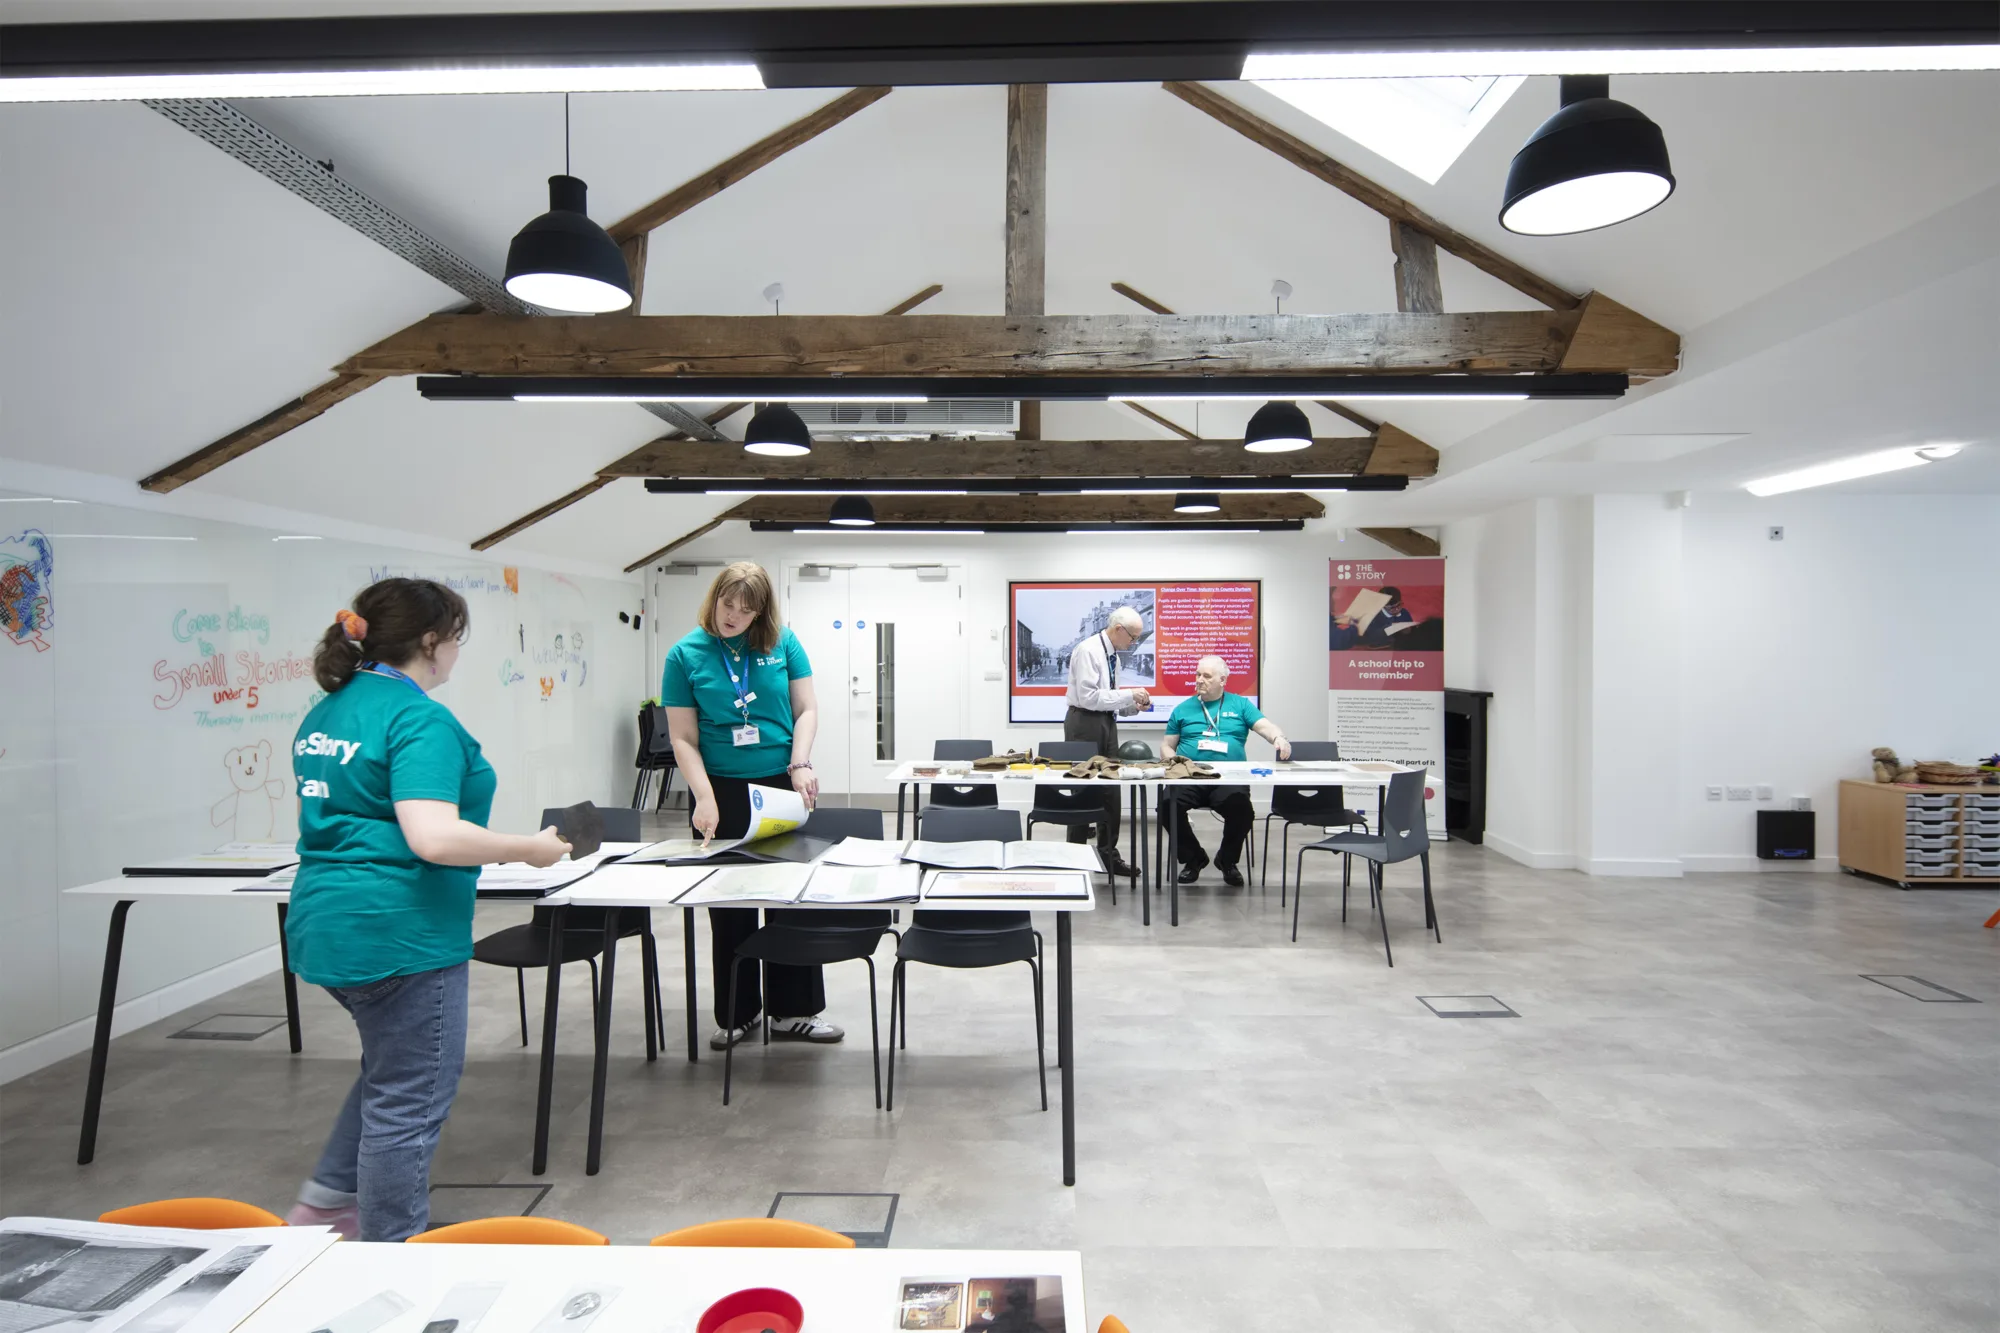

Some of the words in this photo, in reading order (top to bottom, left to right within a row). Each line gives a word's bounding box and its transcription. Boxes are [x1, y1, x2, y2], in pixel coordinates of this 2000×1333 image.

[172, 608, 221, 642] Come
[227, 604, 270, 645] along
[1348, 660, 1357, 668] A
[1358, 659, 1391, 668] school
[1394, 659, 1412, 670] trip
[1414, 660, 1425, 668] to
[1359, 671, 1414, 679] remember
[154, 653, 227, 710] Small
[213, 688, 244, 704] under
[246, 686, 259, 708] 5
